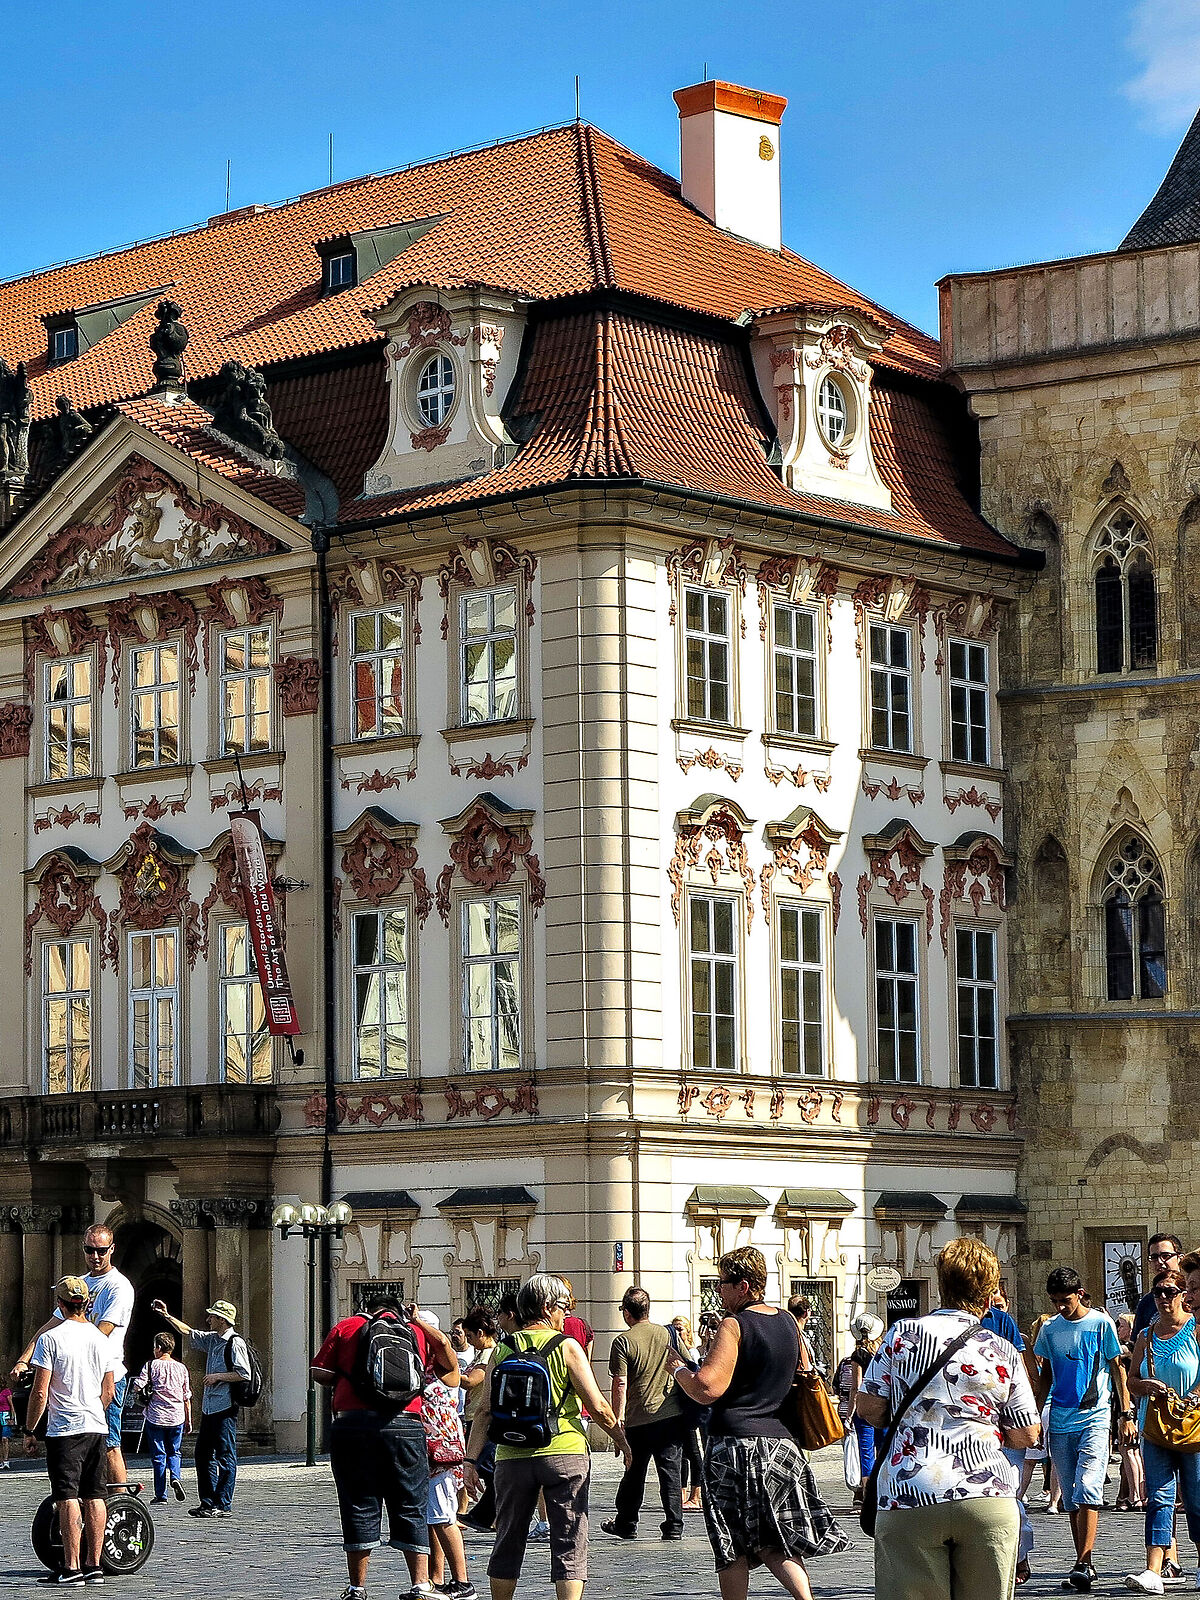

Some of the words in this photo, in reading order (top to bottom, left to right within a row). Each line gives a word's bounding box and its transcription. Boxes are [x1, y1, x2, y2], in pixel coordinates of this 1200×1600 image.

[255, 857, 266, 892] World
[260, 893, 270, 912] Old
[265, 914, 274, 932] the
[267, 934, 276, 945] of
[270, 949, 280, 966] Art
[274, 968, 284, 988] The
[887, 1298, 917, 1309] OKSHOP
[104, 1510, 127, 1536] rent
[105, 1539, 123, 1560] me
